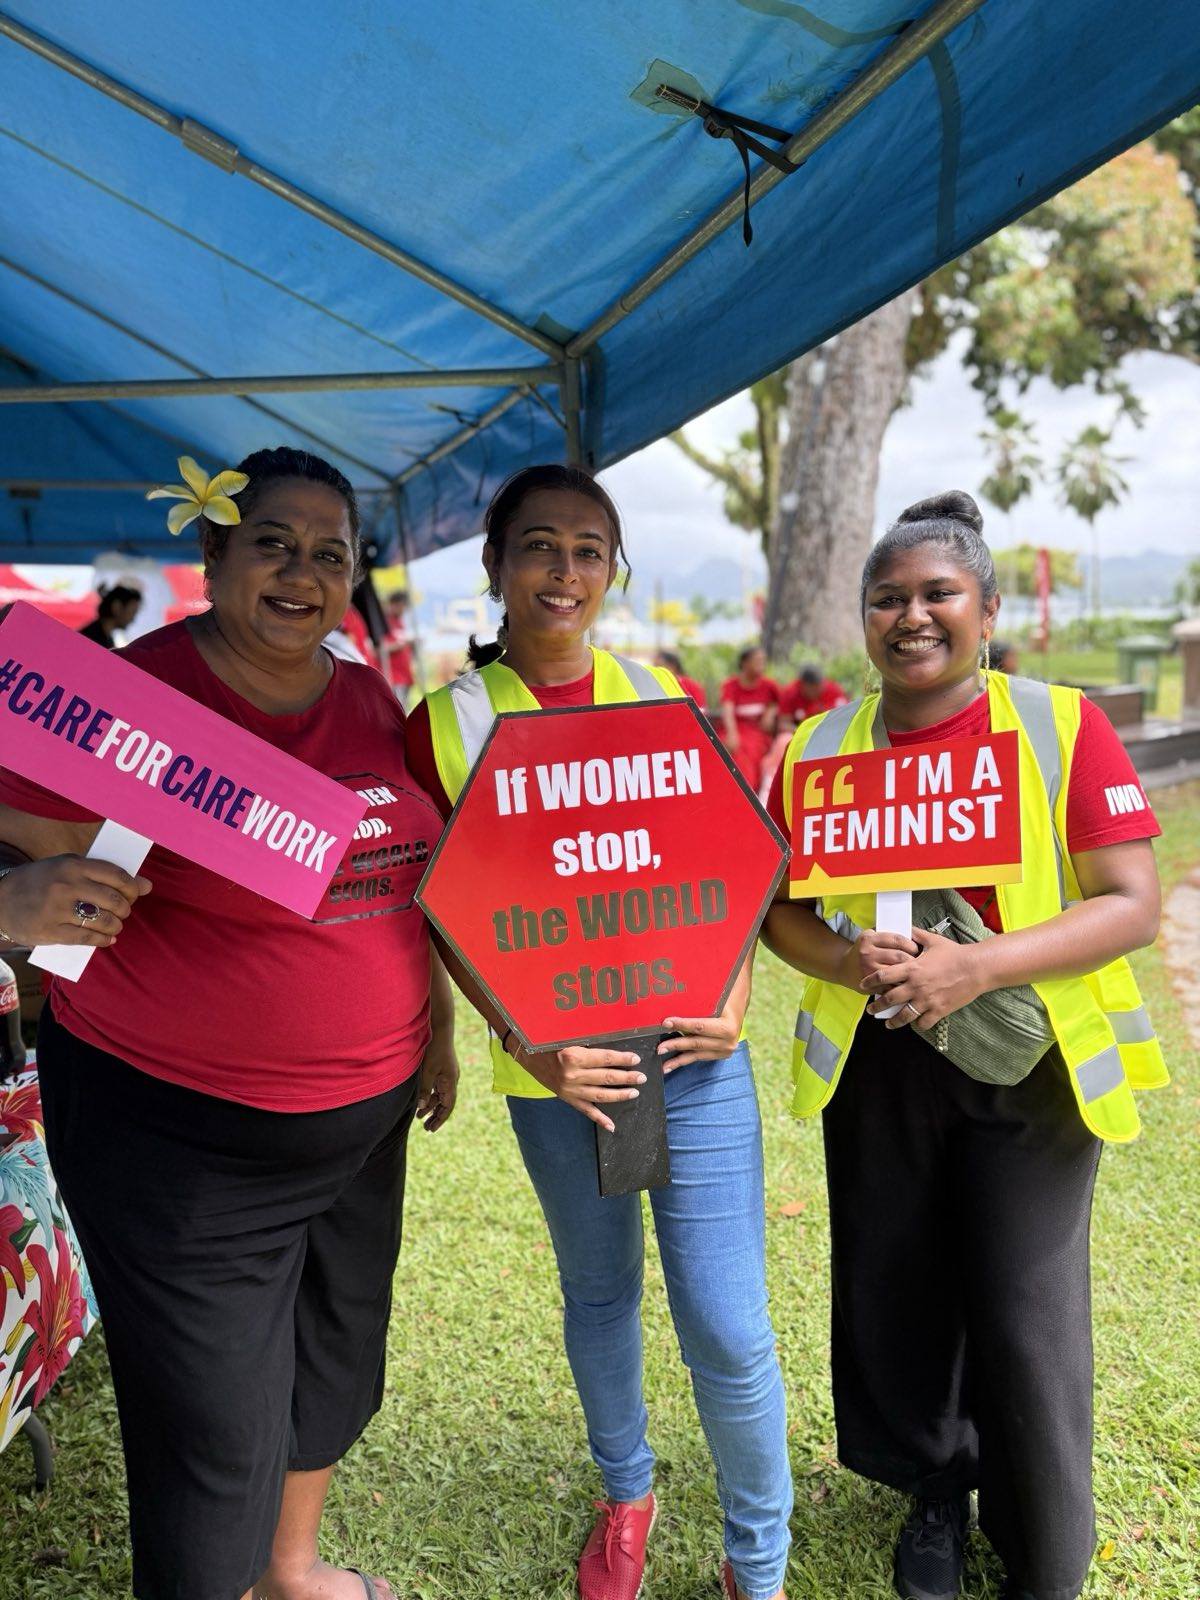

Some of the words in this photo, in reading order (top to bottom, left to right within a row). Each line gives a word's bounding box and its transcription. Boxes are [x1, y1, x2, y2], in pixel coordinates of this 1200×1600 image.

[0, 659, 338, 874] #CAREFORCAREWORK
[494, 767, 528, 816] If
[535, 748, 703, 811] WOMEN
[885, 751, 953, 800] I'M
[971, 745, 1002, 790] A
[803, 794, 1003, 856] FEMINIST
[1104, 783, 1146, 816] IWD
[351, 839, 429, 874] WORLD
[552, 827, 662, 877] stop,
[329, 876, 395, 905] stops.
[492, 904, 568, 952] the
[576, 878, 728, 941] WORLD
[552, 958, 687, 1011] stops.
